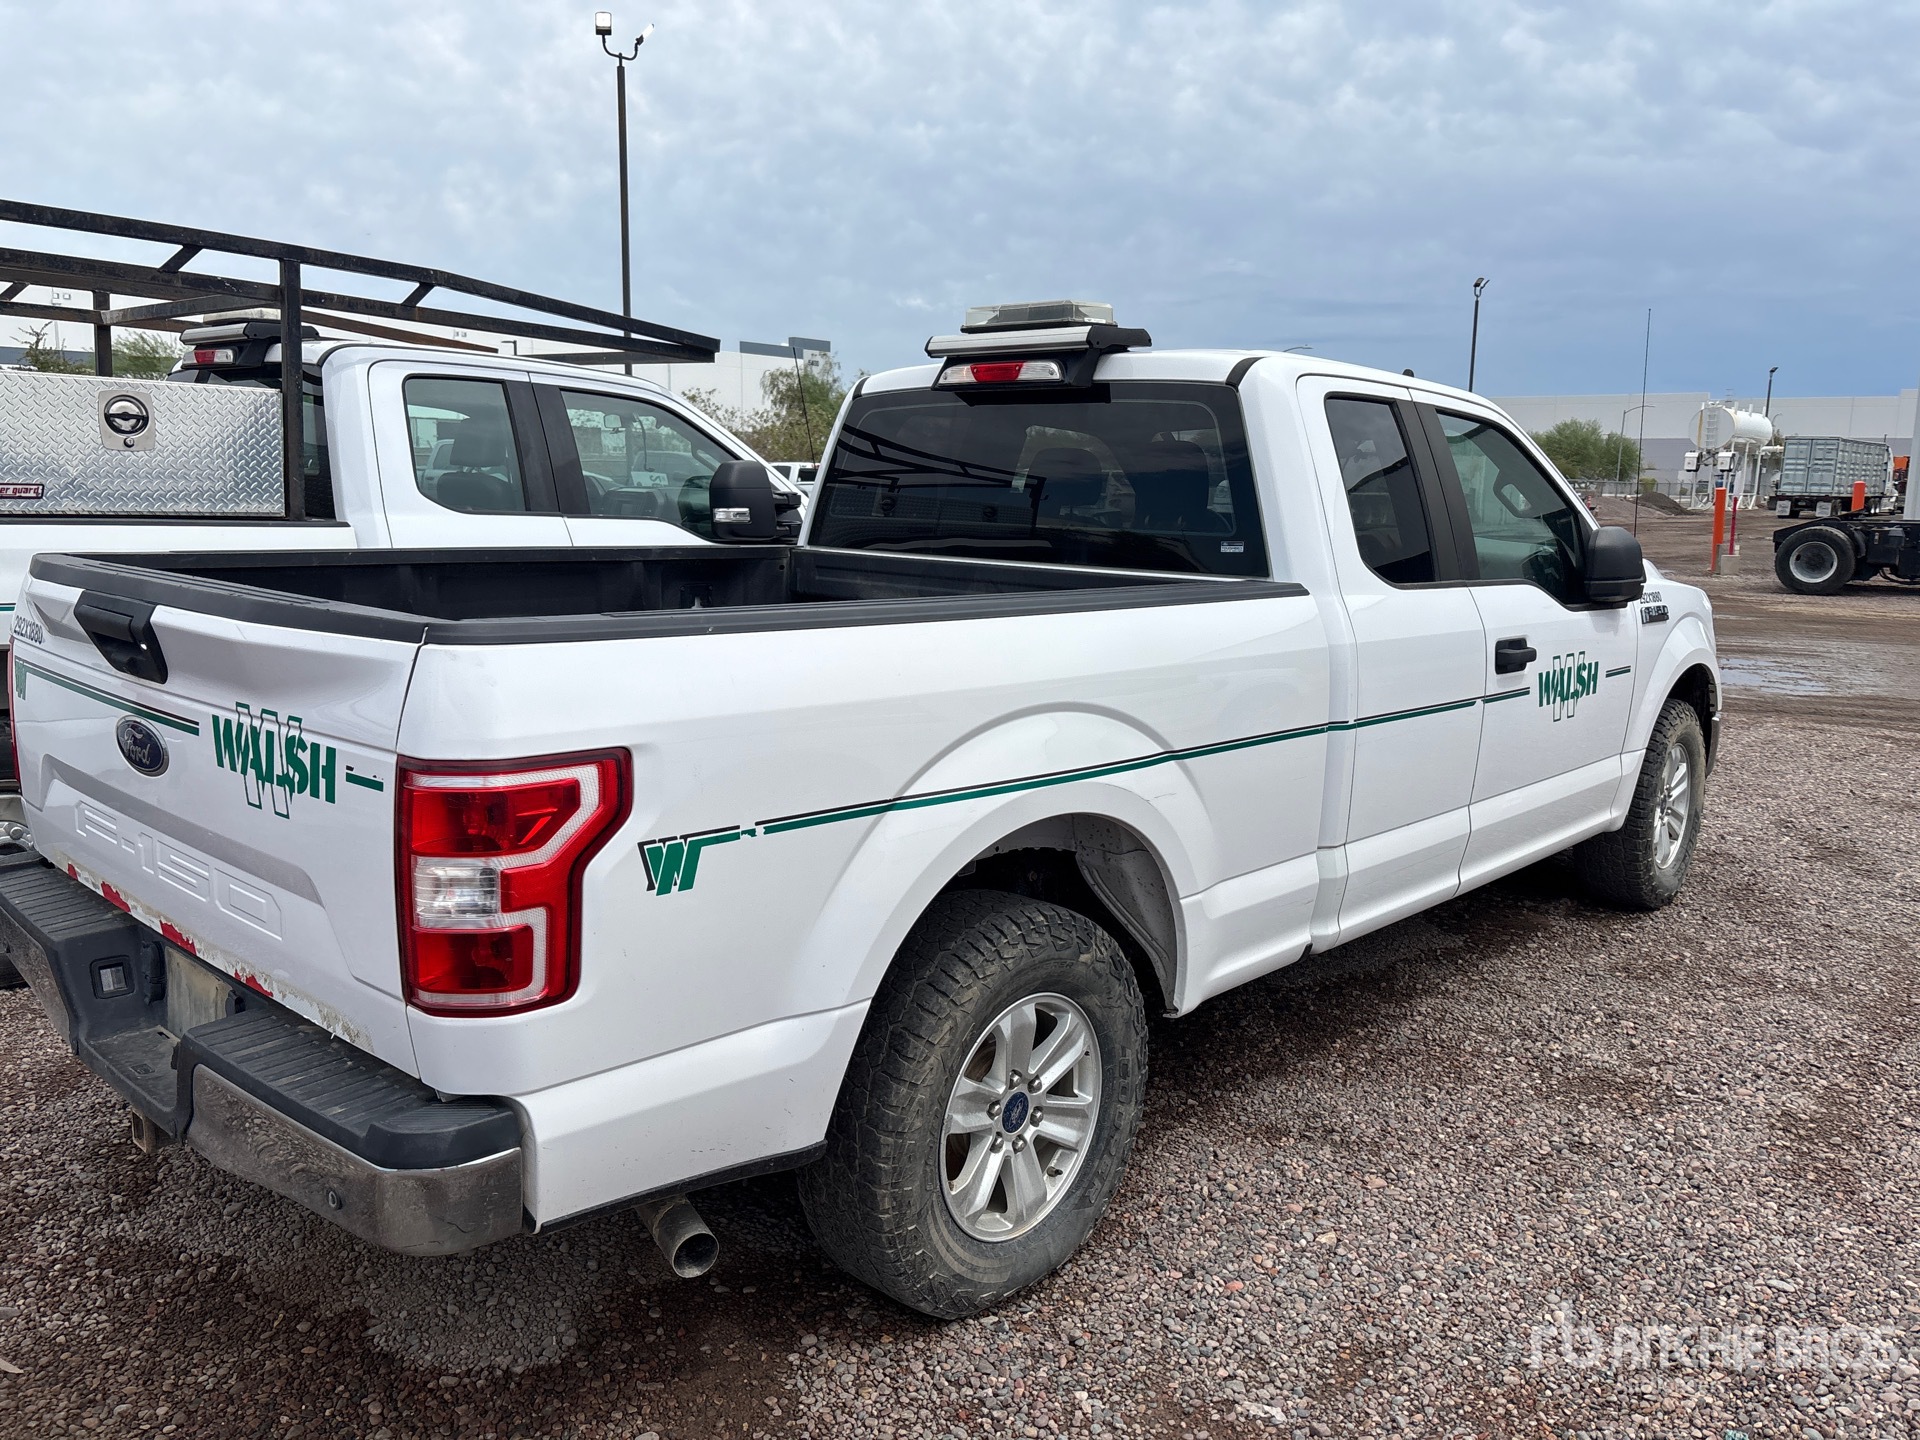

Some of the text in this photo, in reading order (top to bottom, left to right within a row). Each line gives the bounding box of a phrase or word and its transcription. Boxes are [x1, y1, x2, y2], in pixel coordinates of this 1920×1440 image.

[12, 486, 40, 496] guard
[1538, 661, 1599, 708] WALSH
[212, 714, 337, 805] WALSH
[75, 799, 283, 941] F-150
